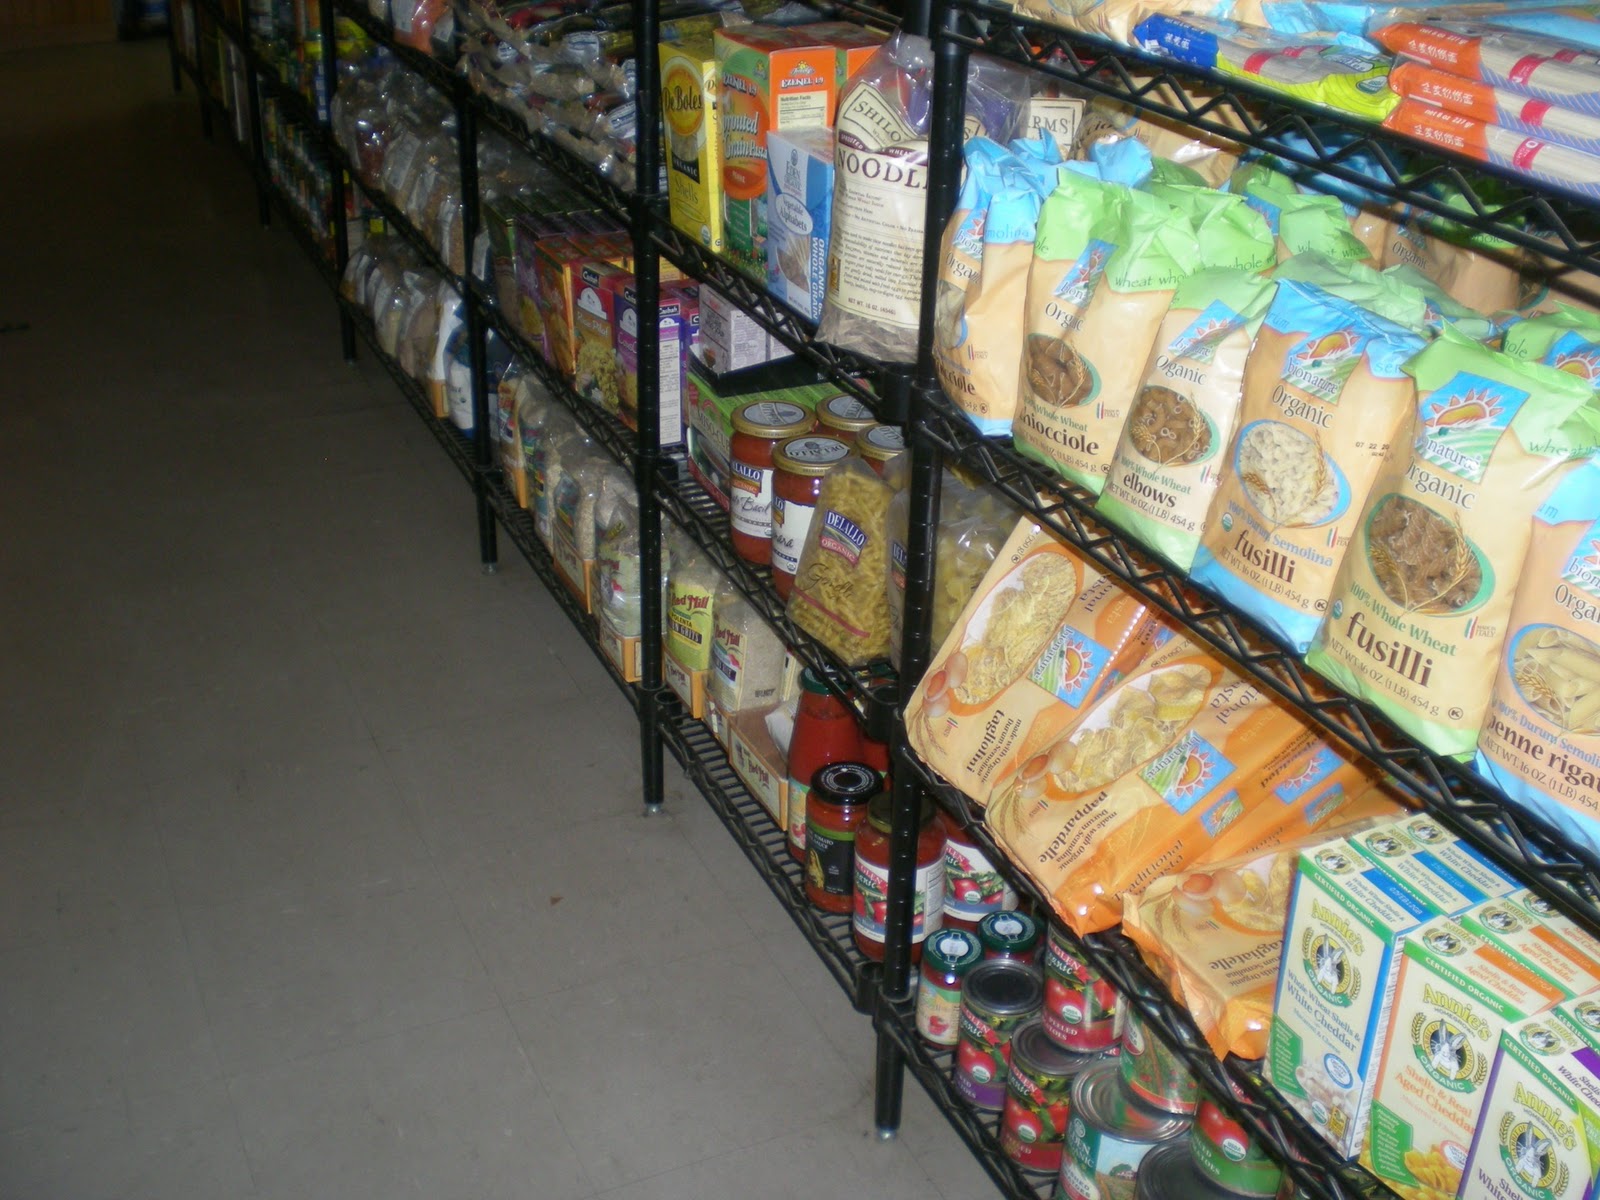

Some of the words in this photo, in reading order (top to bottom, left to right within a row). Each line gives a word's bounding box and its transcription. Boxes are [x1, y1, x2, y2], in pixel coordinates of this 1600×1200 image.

[838, 150, 928, 190] NOODL
[674, 174, 699, 204] Shells
[779, 209, 808, 232] Alphabets
[1392, 240, 1428, 270] Organic
[1115, 270, 1153, 287] wheat
[1272, 384, 1334, 429] Organic
[1060, 415, 1088, 433] Wheat
[1355, 440, 1364, 448] 07
[1369, 442, 1377, 450] 22
[1123, 472, 1177, 508] elbows
[1135, 463, 1160, 482] Whole
[1161, 474, 1192, 495] Wheat
[742, 496, 771, 516] Basil
[827, 511, 866, 547] DELALLO
[1170, 513, 1187, 527] 454
[1187, 519, 1196, 532] g
[821, 537, 856, 563] ORGANIC
[1233, 529, 1296, 585] fusilli
[1272, 533, 1333, 568] Semolina
[1242, 563, 1250, 576] 16
[1285, 589, 1302, 604] 454
[1301, 597, 1310, 609] g
[687, 594, 710, 611] Mill
[1350, 581, 1371, 608] 100%
[1371, 598, 1407, 633] Whole
[1409, 623, 1458, 657] Wheat
[1476, 629, 1496, 638] ITALY
[725, 629, 742, 646] Mill
[1346, 611, 1434, 689] fusilli
[1329, 637, 1344, 656] NET
[1360, 661, 1369, 675] 16
[1392, 682, 1410, 700] LB)
[1410, 692, 1430, 710] 454
[1429, 704, 1440, 717] g
[966, 708, 1006, 773] tagliolini
[999, 718, 1014, 750] Durum
[1010, 718, 1022, 742] made
[1519, 714, 1559, 746] Durum
[976, 745, 1001, 778] Semolina
[1001, 739, 1012, 759] with
[982, 755, 1002, 784] Organic
[1484, 735, 1502, 755] NET
[1519, 761, 1530, 775] 16
[1558, 781, 1577, 801] LB)
[1578, 794, 1599, 811] 454
[1039, 790, 1109, 864] pappardelle
[1081, 808, 1109, 835] Durum
[1084, 826, 1100, 846] with
[1098, 811, 1118, 830] made
[1055, 830, 1085, 864] Semolina
[1058, 846, 1086, 873] Organic
[1314, 872, 1346, 903] CERTIFIED
[1345, 900, 1375, 927] ORGANIC
[1365, 897, 1397, 923] Cheddar
[1311, 898, 1365, 957] Annie's
[1054, 945, 1081, 971] GLEN
[1209, 939, 1285, 971] tagliatelle
[1229, 971, 1265, 987] Organic
[1308, 969, 1343, 1005] ORGANIC
[1425, 956, 1466, 988] CERTIFIED
[1467, 984, 1504, 1013] ORGANIC
[1286, 980, 1313, 1013] White
[1314, 1009, 1357, 1053] Cheddar
[1288, 968, 1308, 994] Whole
[1307, 990, 1332, 1015] Wheat
[1331, 1010, 1354, 1036] Shells
[1422, 982, 1493, 1042] Annie's
[966, 1009, 991, 1034] GLEN
[1013, 1065, 1038, 1093] GLEN
[1419, 1054, 1465, 1091] ORGANIC
[1504, 1038, 1541, 1074] CERTIFIED
[1542, 1072, 1576, 1106] ORGANIC
[1558, 1065, 1582, 1090] White
[1395, 1071, 1424, 1099] Aged
[1425, 1093, 1476, 1135] Cheddar
[1406, 1064, 1436, 1094] Shells
[1448, 1094, 1473, 1118] Real
[1513, 1080, 1577, 1152] Annie's
[1504, 1156, 1546, 1199] ORGANIC
